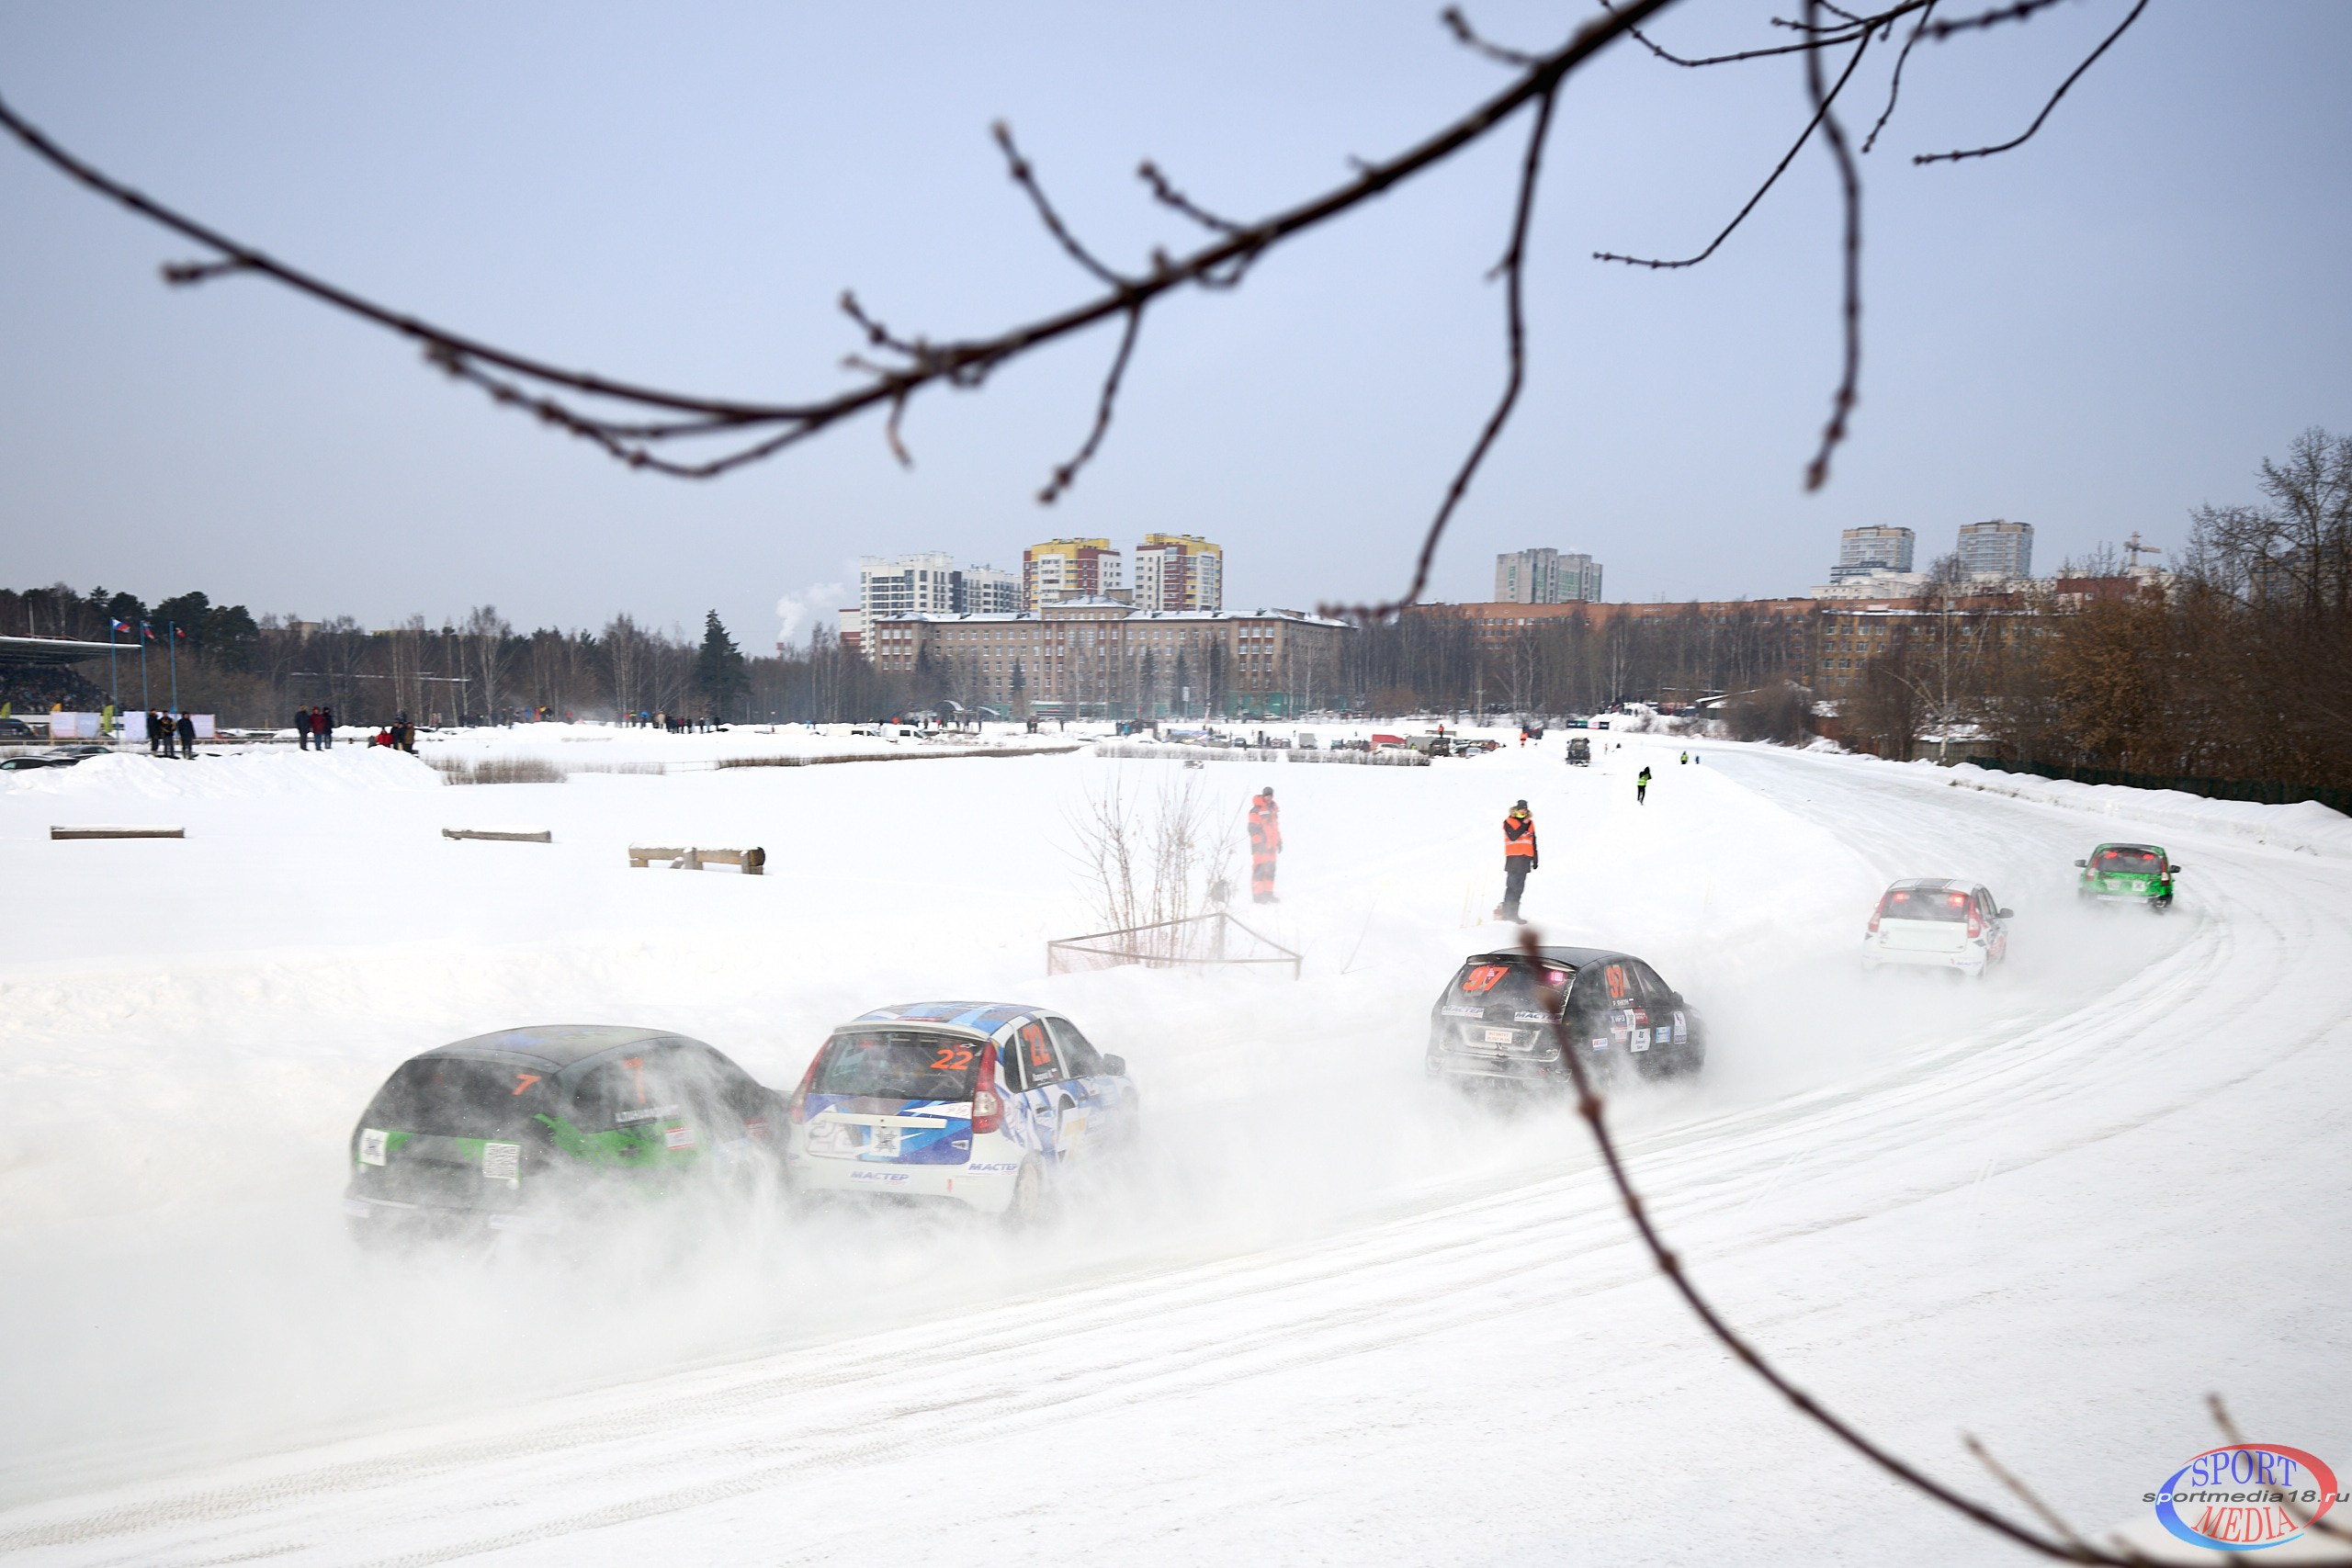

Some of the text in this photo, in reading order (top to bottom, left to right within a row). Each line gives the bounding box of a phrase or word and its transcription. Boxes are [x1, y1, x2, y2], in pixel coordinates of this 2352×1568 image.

[1462, 964, 1510, 991] 97
[1607, 965, 1624, 998] 97
[1023, 1023, 1051, 1066] 22
[930, 1049, 973, 1070] 22
[512, 1074, 542, 1096] 7
[851, 1170, 910, 1180] МАСТЕР
